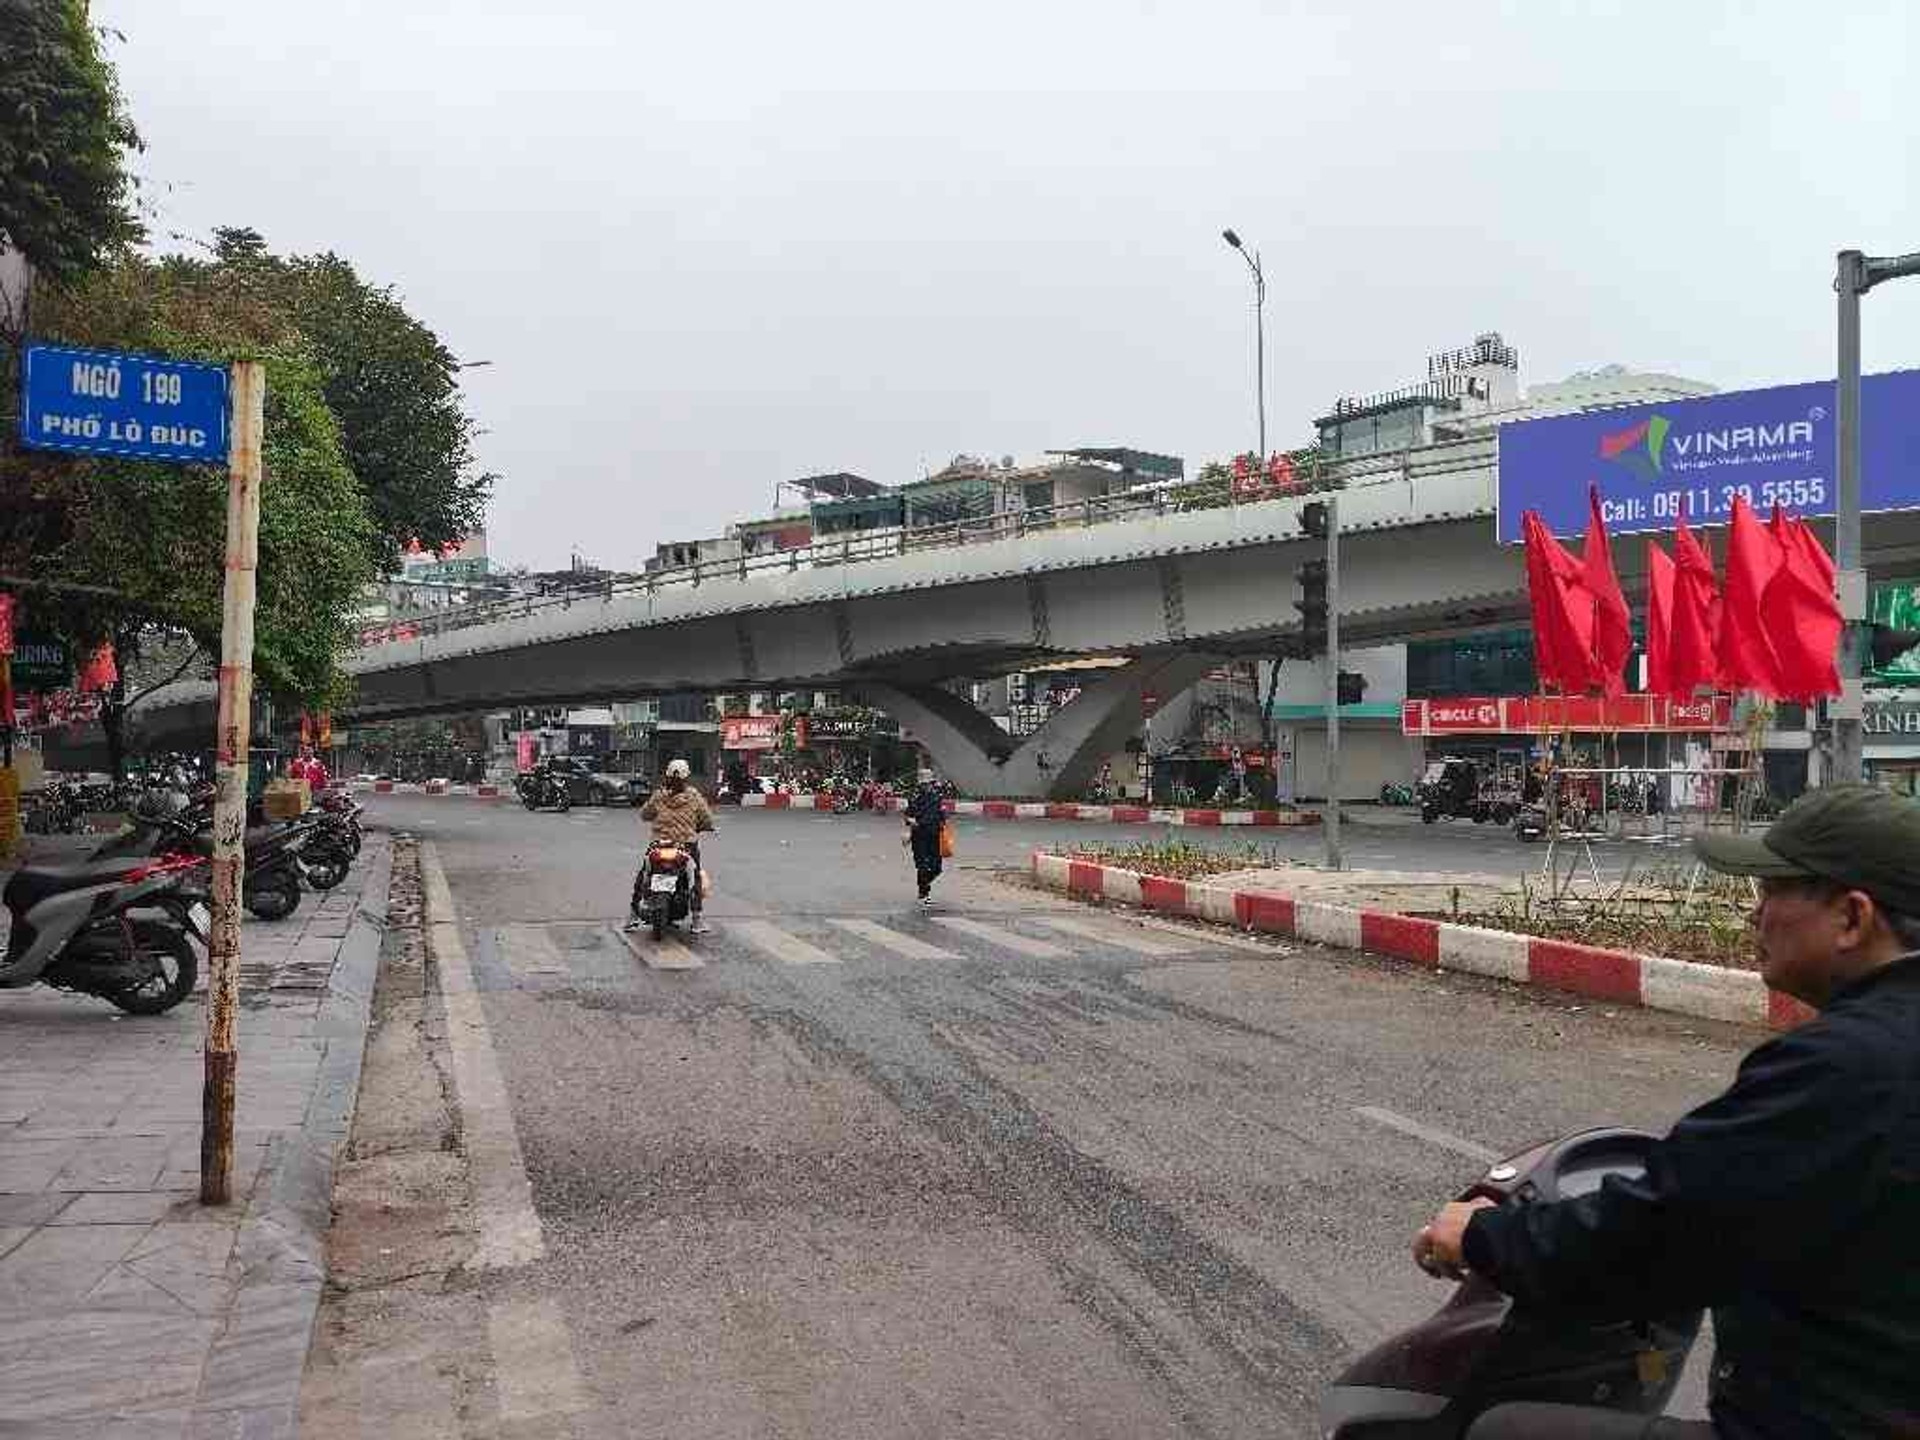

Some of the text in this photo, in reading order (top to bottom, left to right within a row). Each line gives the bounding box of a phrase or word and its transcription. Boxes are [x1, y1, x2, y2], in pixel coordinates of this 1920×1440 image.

[142, 371, 182, 406] 199
[42, 411, 102, 438] PHỐ
[109, 418, 142, 442] LÒ
[1673, 421, 1813, 455] VINAMA
[1602, 498, 1647, 523] Call:
